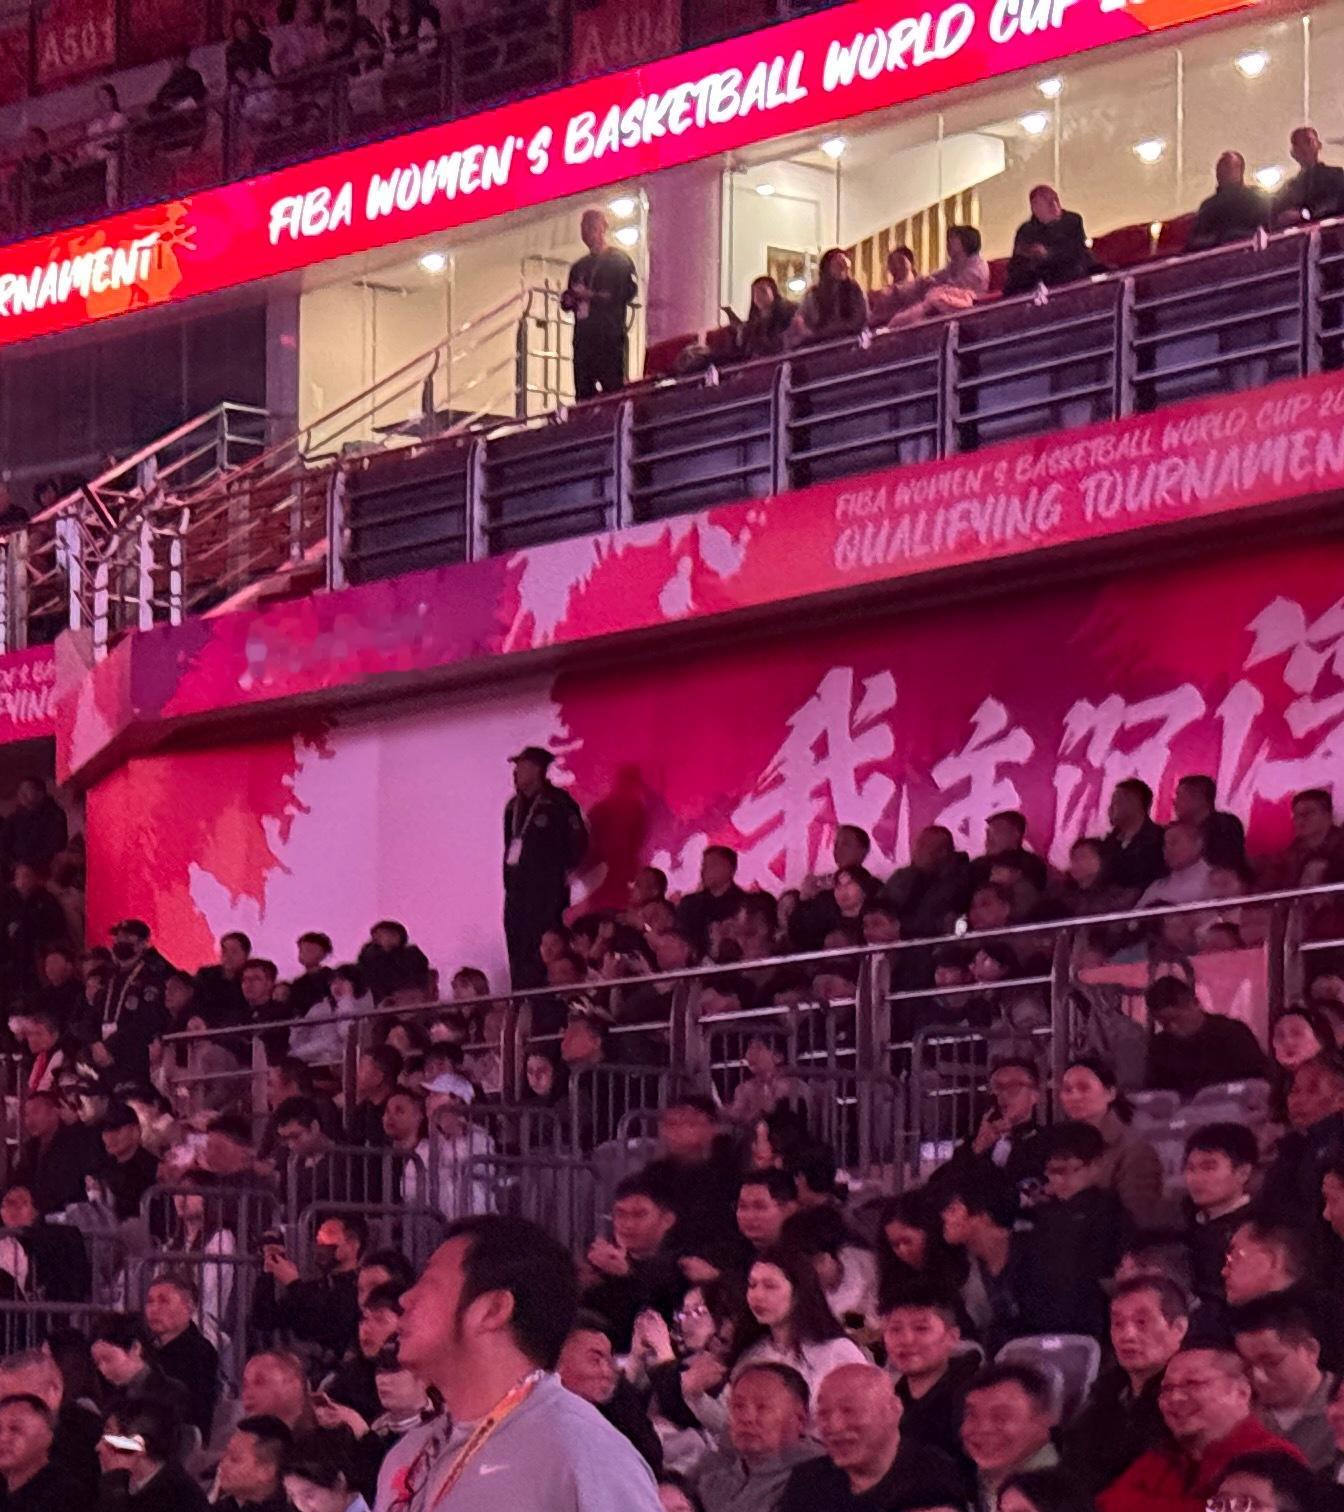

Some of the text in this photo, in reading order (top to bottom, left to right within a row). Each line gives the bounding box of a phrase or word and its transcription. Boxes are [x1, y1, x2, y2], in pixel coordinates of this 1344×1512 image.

[268, 180, 353, 246] FIBA
[364, 125, 553, 222] WOMEN'S
[562, 48, 810, 166] BASKETBALL
[821, 1, 977, 93] WORLD
[835, 487, 886, 520] FIBA
[894, 462, 1007, 512] WOMEN'S
[1014, 430, 1153, 481] BASKETBALL
[1161, 406, 1248, 451] WORLD
[1256, 394, 1311, 431] CUP
[833, 481, 1064, 571] QUALIFYING
